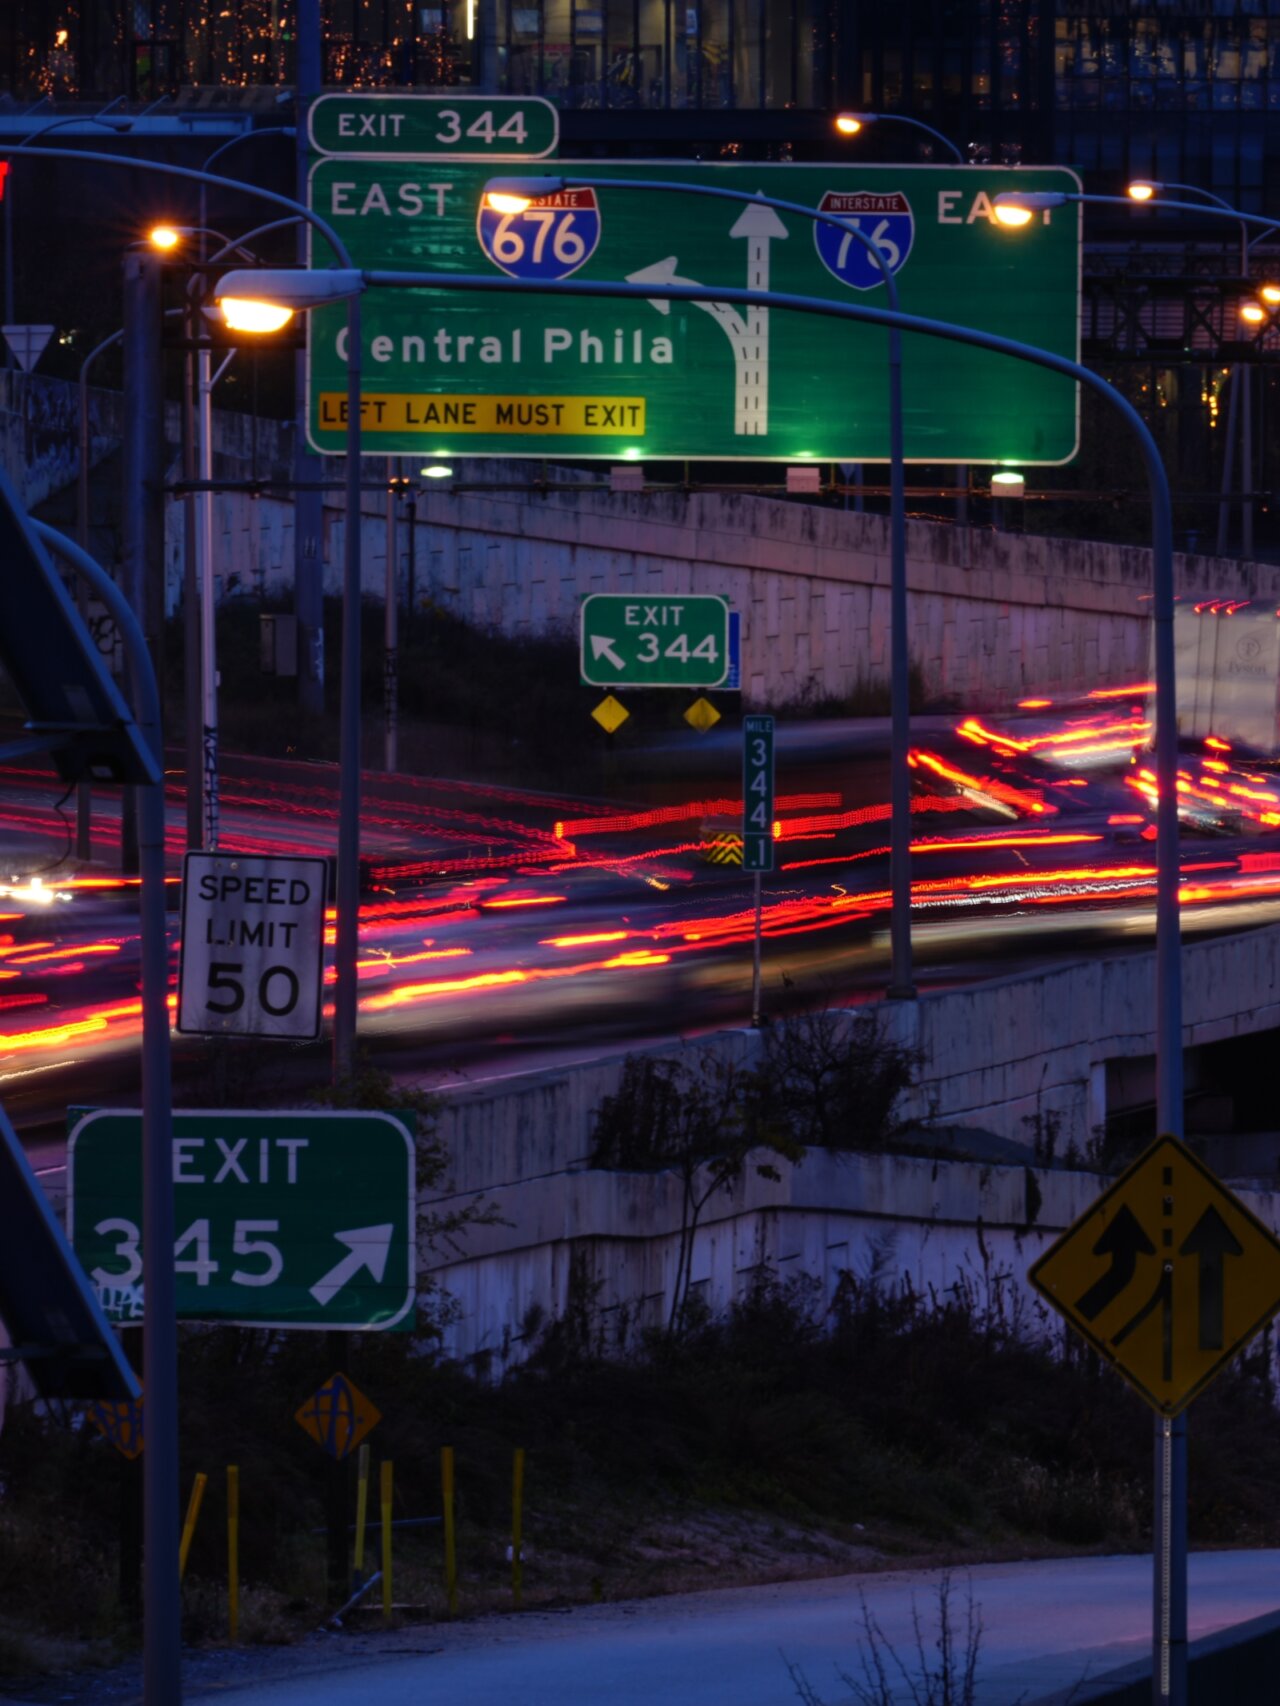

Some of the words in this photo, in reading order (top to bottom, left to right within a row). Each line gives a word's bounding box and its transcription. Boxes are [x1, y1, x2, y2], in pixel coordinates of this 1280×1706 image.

[338, 113, 406, 138] EXIT
[435, 110, 529, 145] 344
[331, 182, 454, 217] EAST
[829, 197, 900, 211] INTERSTATE
[937, 190, 1052, 225] EA
[492, 210, 585, 264] 676
[827, 218, 900, 270] 76
[334, 328, 523, 364] Central
[544, 328, 674, 364] Phila
[405, 402, 477, 426] LANE
[496, 403, 565, 427] MUST
[584, 404, 642, 428] EXIT
[624, 605, 685, 627] EXIT
[635, 632, 720, 664] 344
[746, 720, 773, 733] MILE
[198, 874, 311, 906] SPEED
[206, 918, 299, 949] LIMIT
[205, 961, 300, 1017] 50
[171, 1137, 310, 1184] EXIT
[89, 1216, 285, 1288] 345
